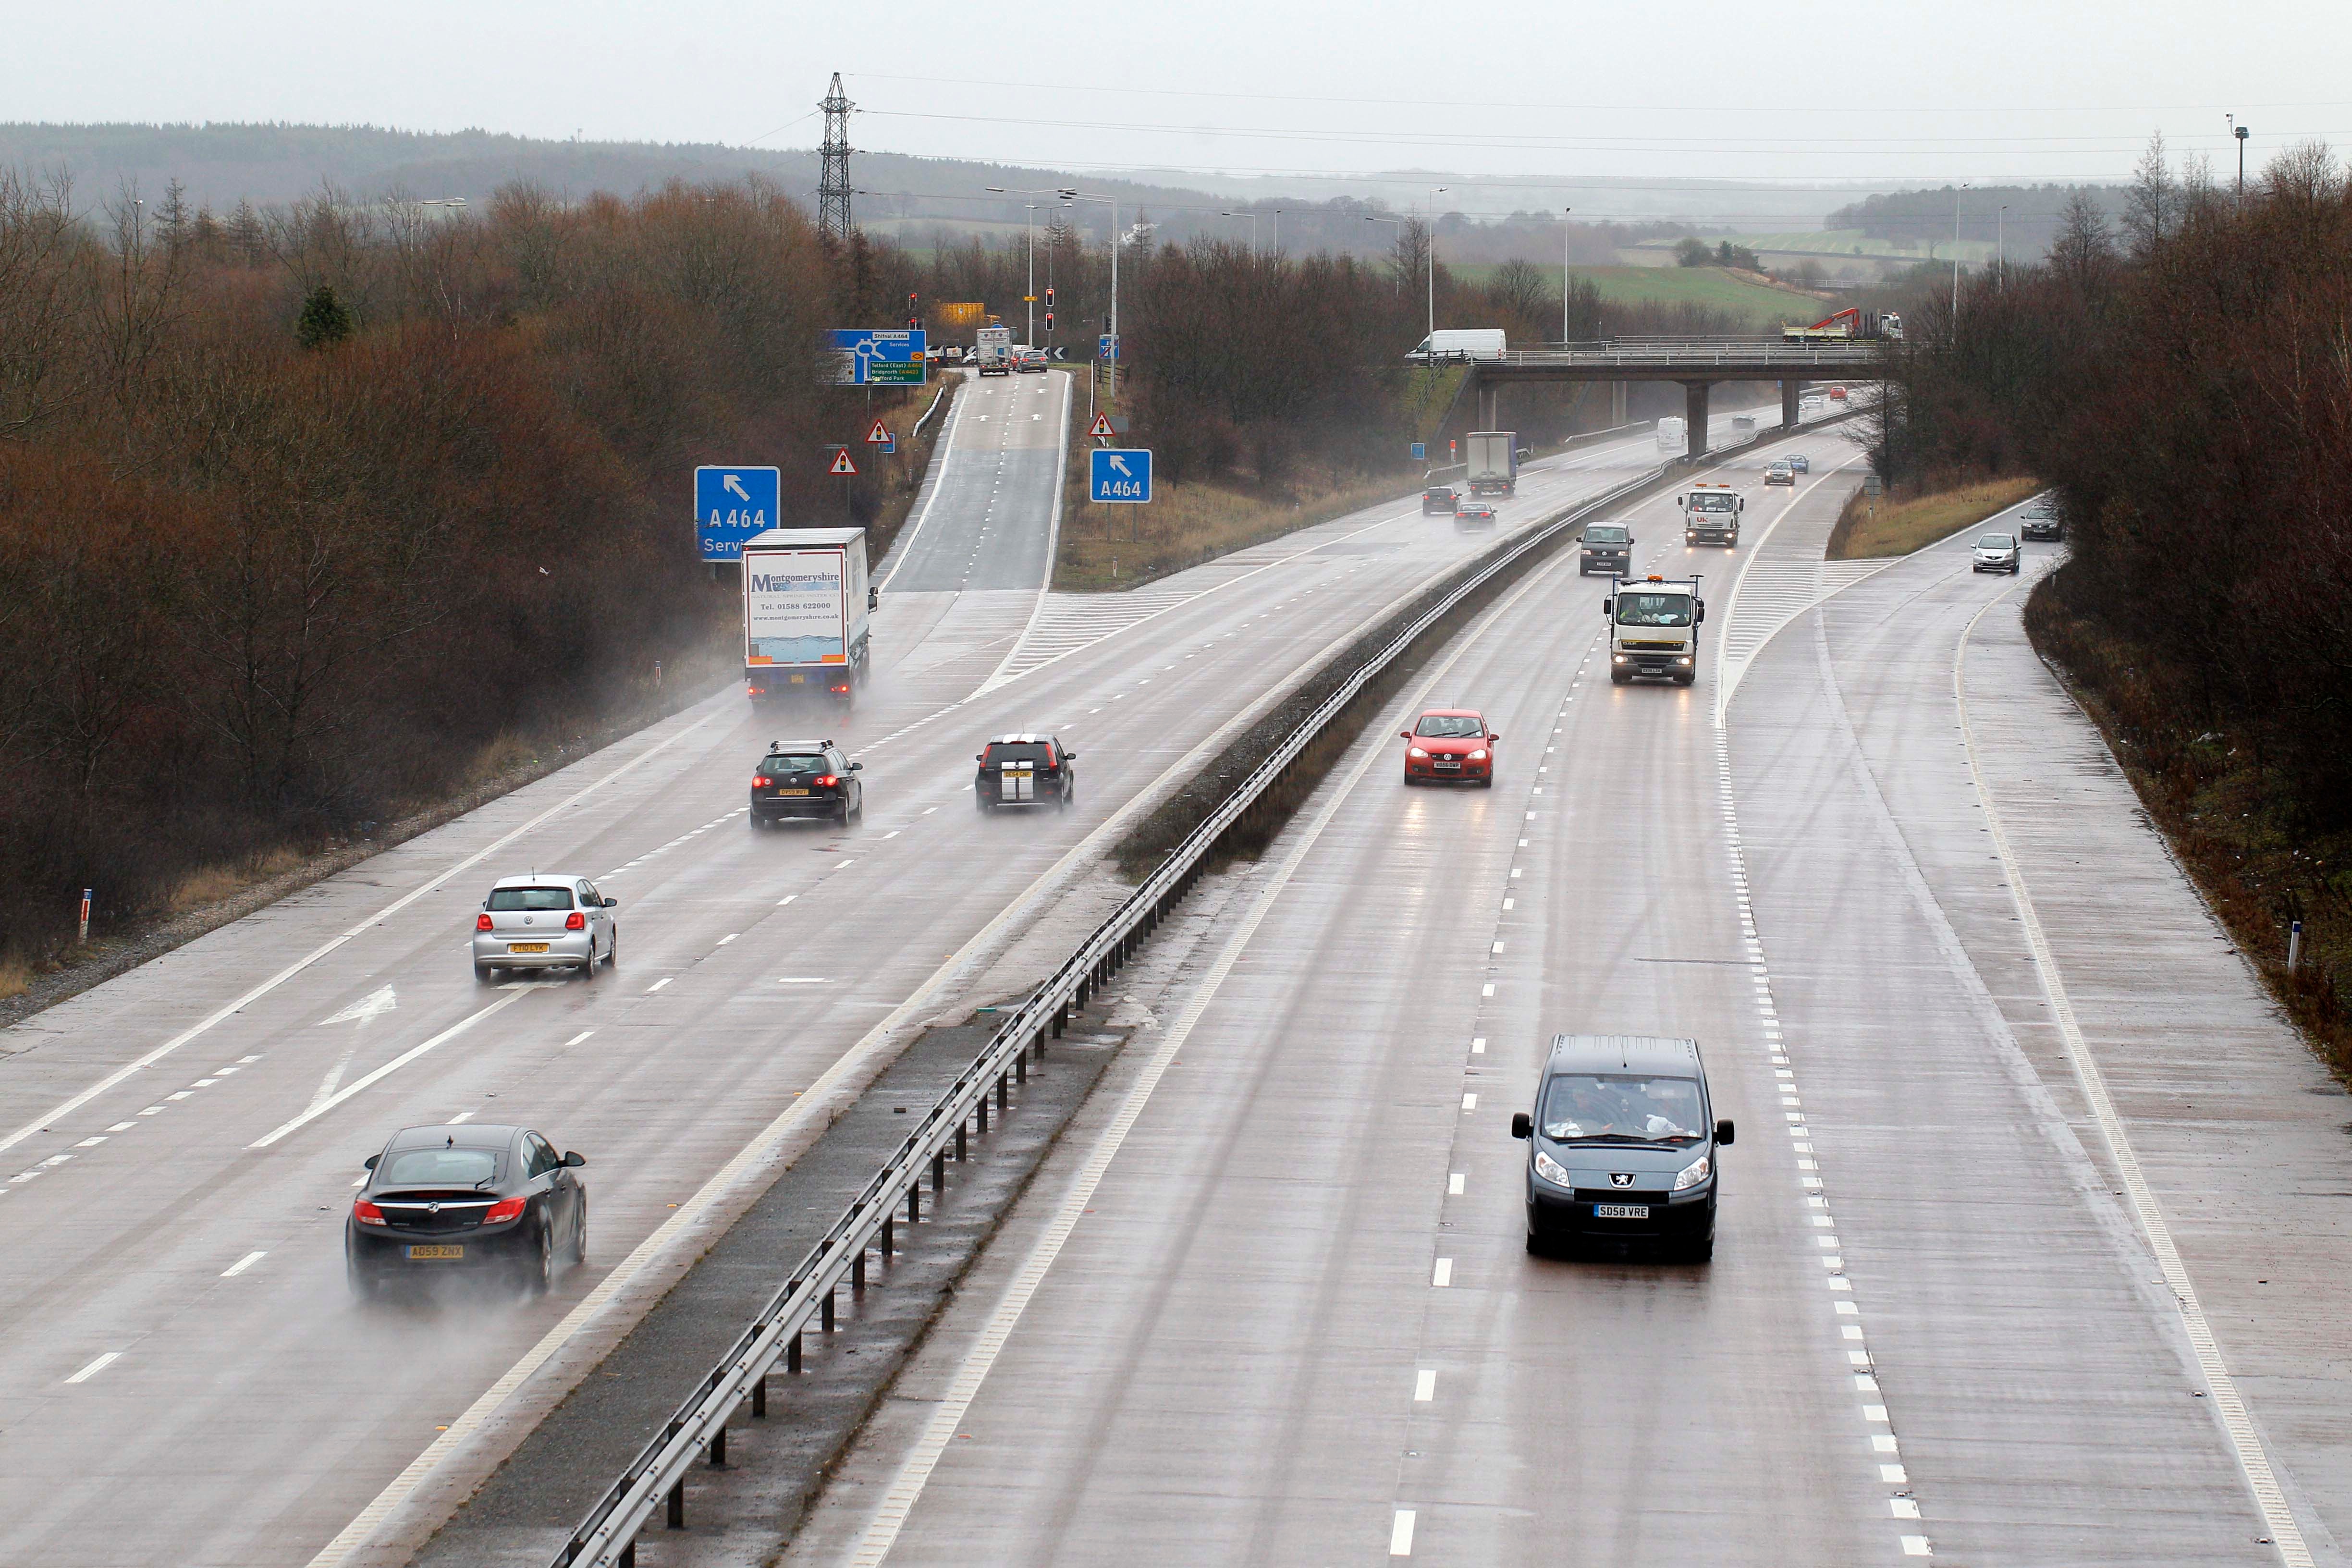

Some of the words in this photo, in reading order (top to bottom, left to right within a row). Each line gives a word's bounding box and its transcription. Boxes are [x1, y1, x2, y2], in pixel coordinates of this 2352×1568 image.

[750, 572, 840, 592] Montgomeryshire
[1600, 1206, 1625, 1216] SD58
[1629, 1207, 1647, 1217] VRE
